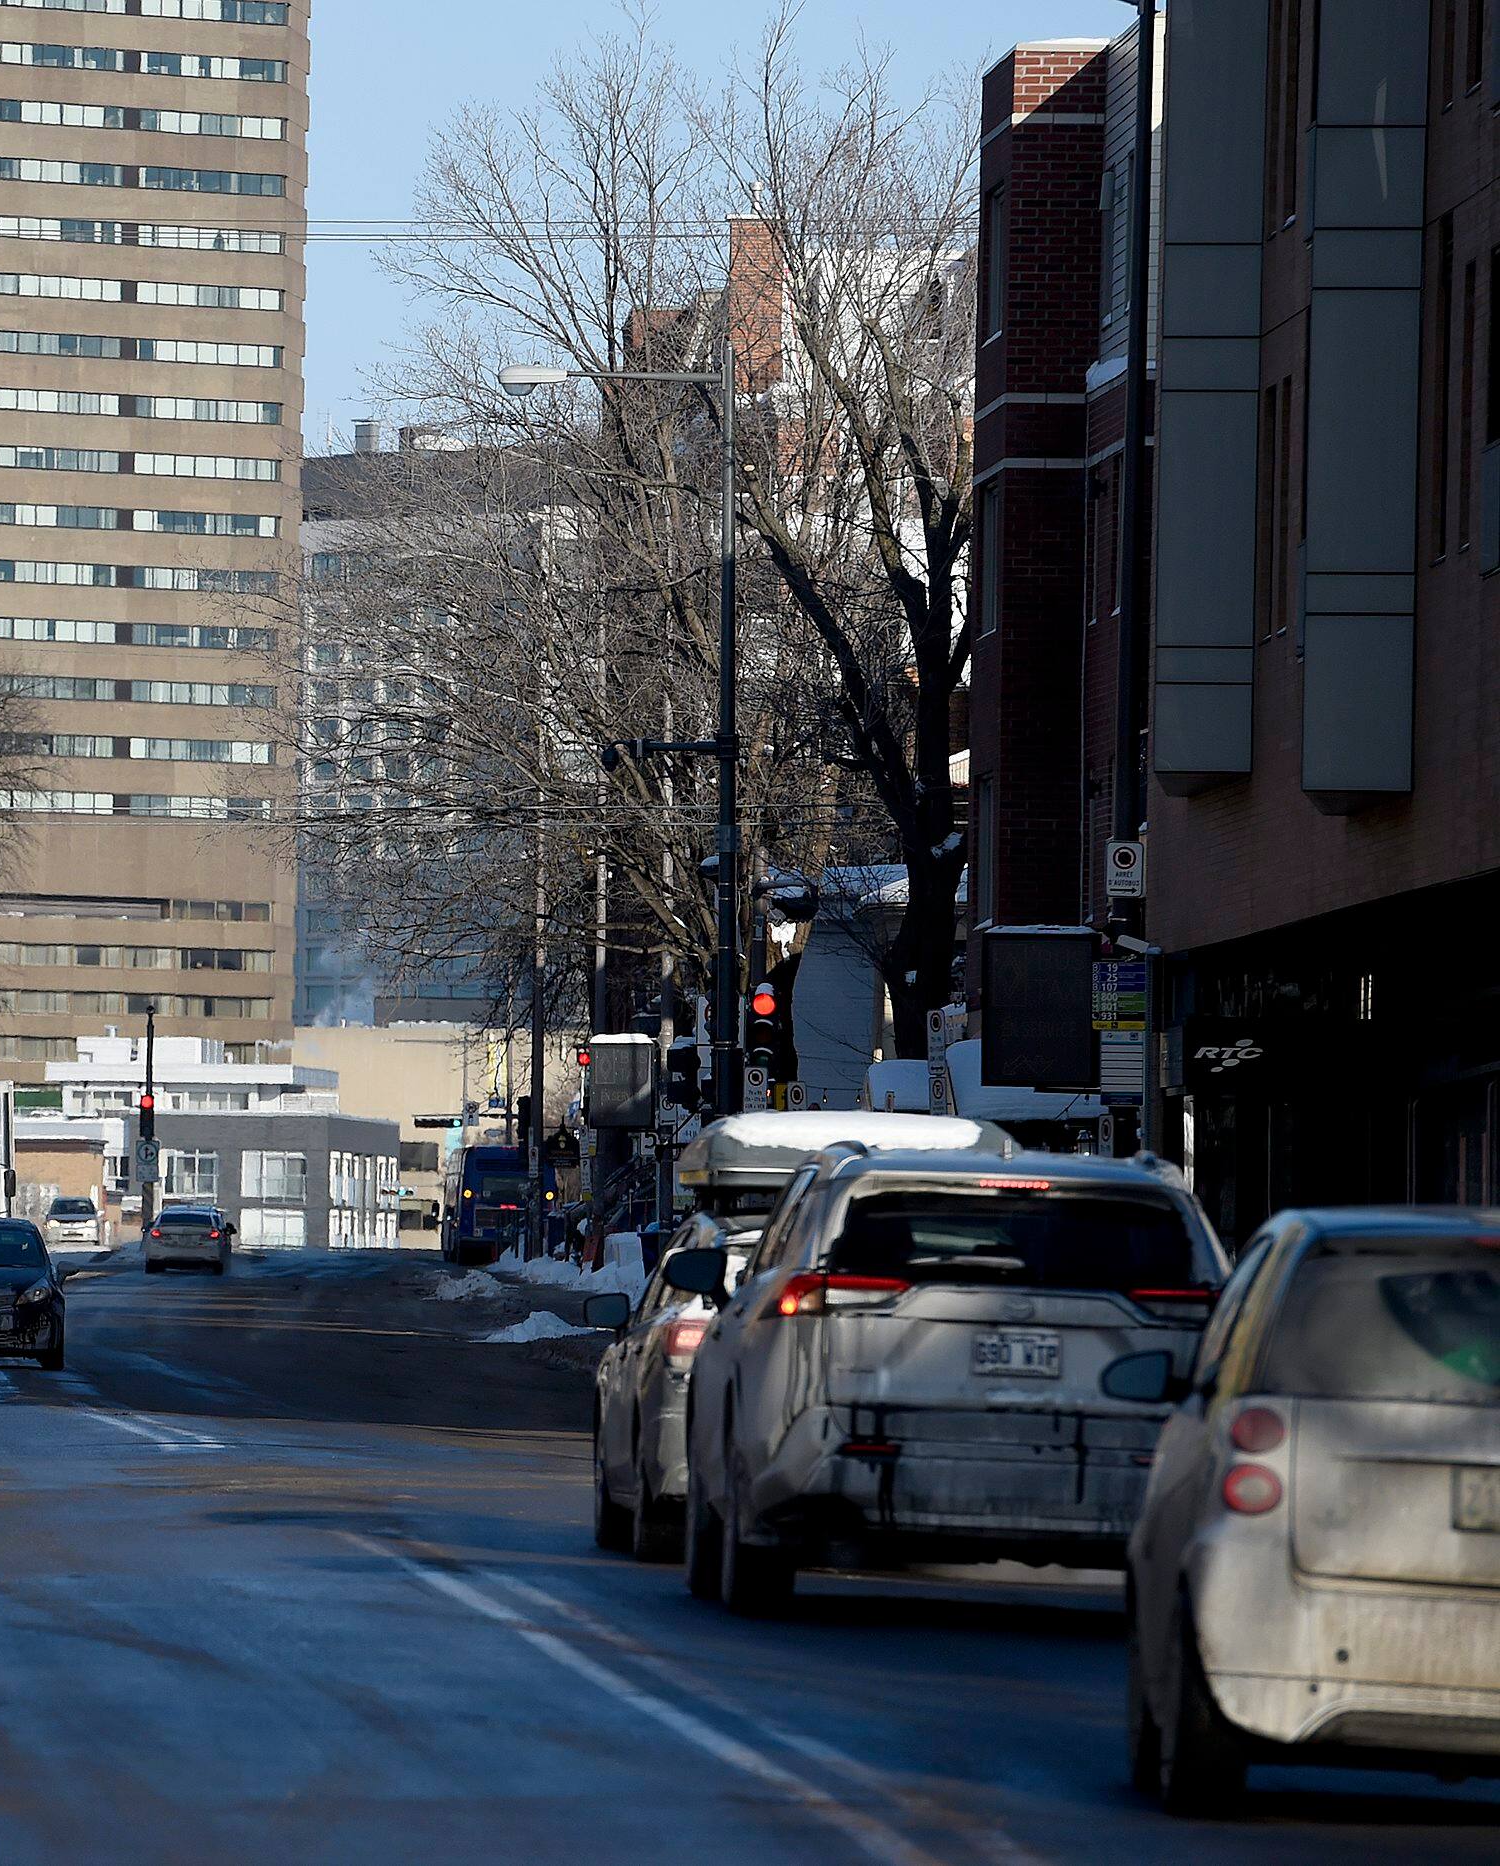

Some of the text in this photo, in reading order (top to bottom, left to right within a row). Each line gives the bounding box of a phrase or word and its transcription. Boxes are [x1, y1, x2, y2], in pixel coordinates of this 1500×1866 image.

[1107, 963, 1118, 972] 19
[1106, 973, 1118, 982] 25
[1101, 983, 1118, 991] 107
[1101, 1012, 1117, 1020] 931
[1194, 1046, 1264, 1059] RTC
